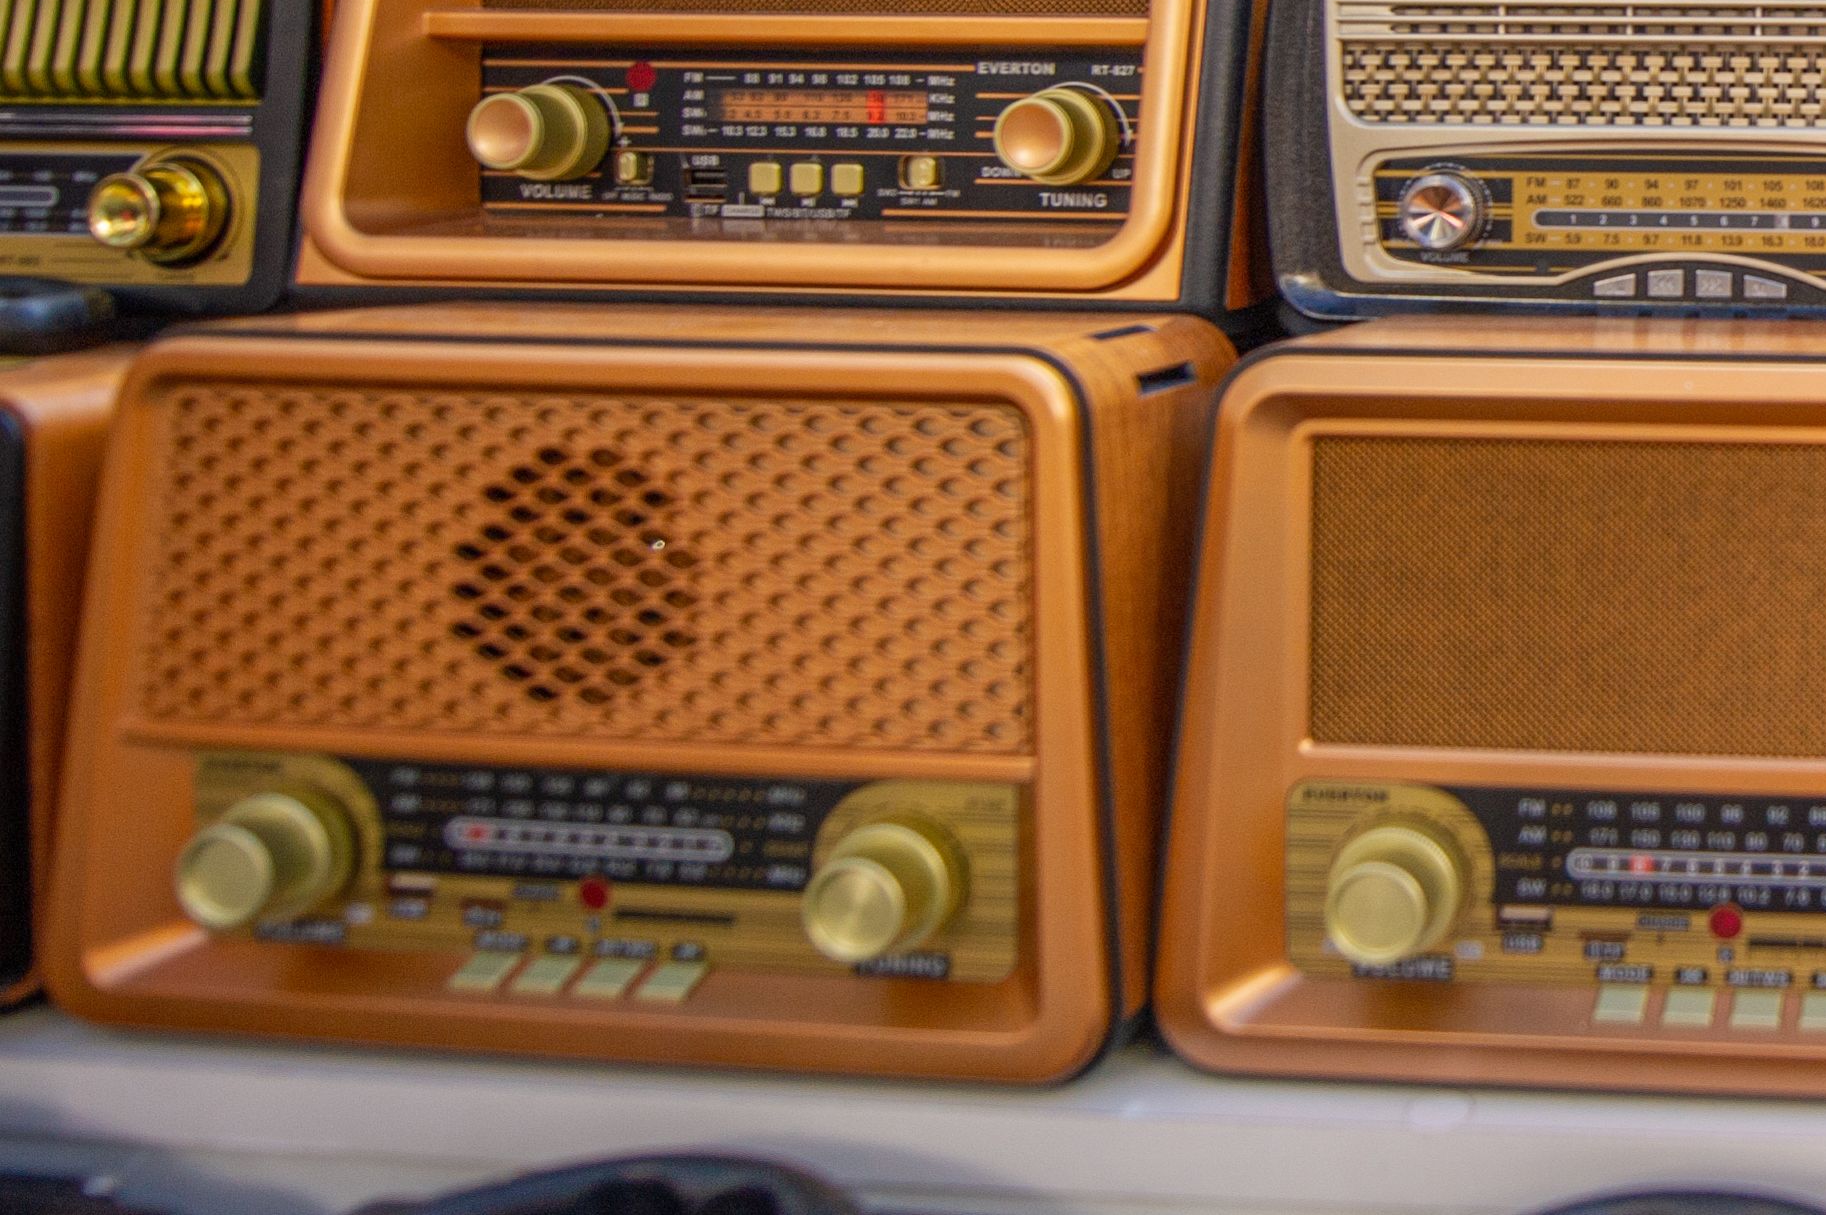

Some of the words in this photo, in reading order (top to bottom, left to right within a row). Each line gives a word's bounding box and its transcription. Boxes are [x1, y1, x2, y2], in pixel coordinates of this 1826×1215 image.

[977, 62, 1056, 75] EVERTON
[1527, 178, 1545, 187] FM
[520, 185, 593, 199] VOLUME
[1039, 192, 1108, 207] TUNING
[1527, 195, 1547, 204] AM
[1720, 197, 1746, 206] 1250
[1659, 216, 1667, 226] 4
[1526, 235, 1546, 244] SW
